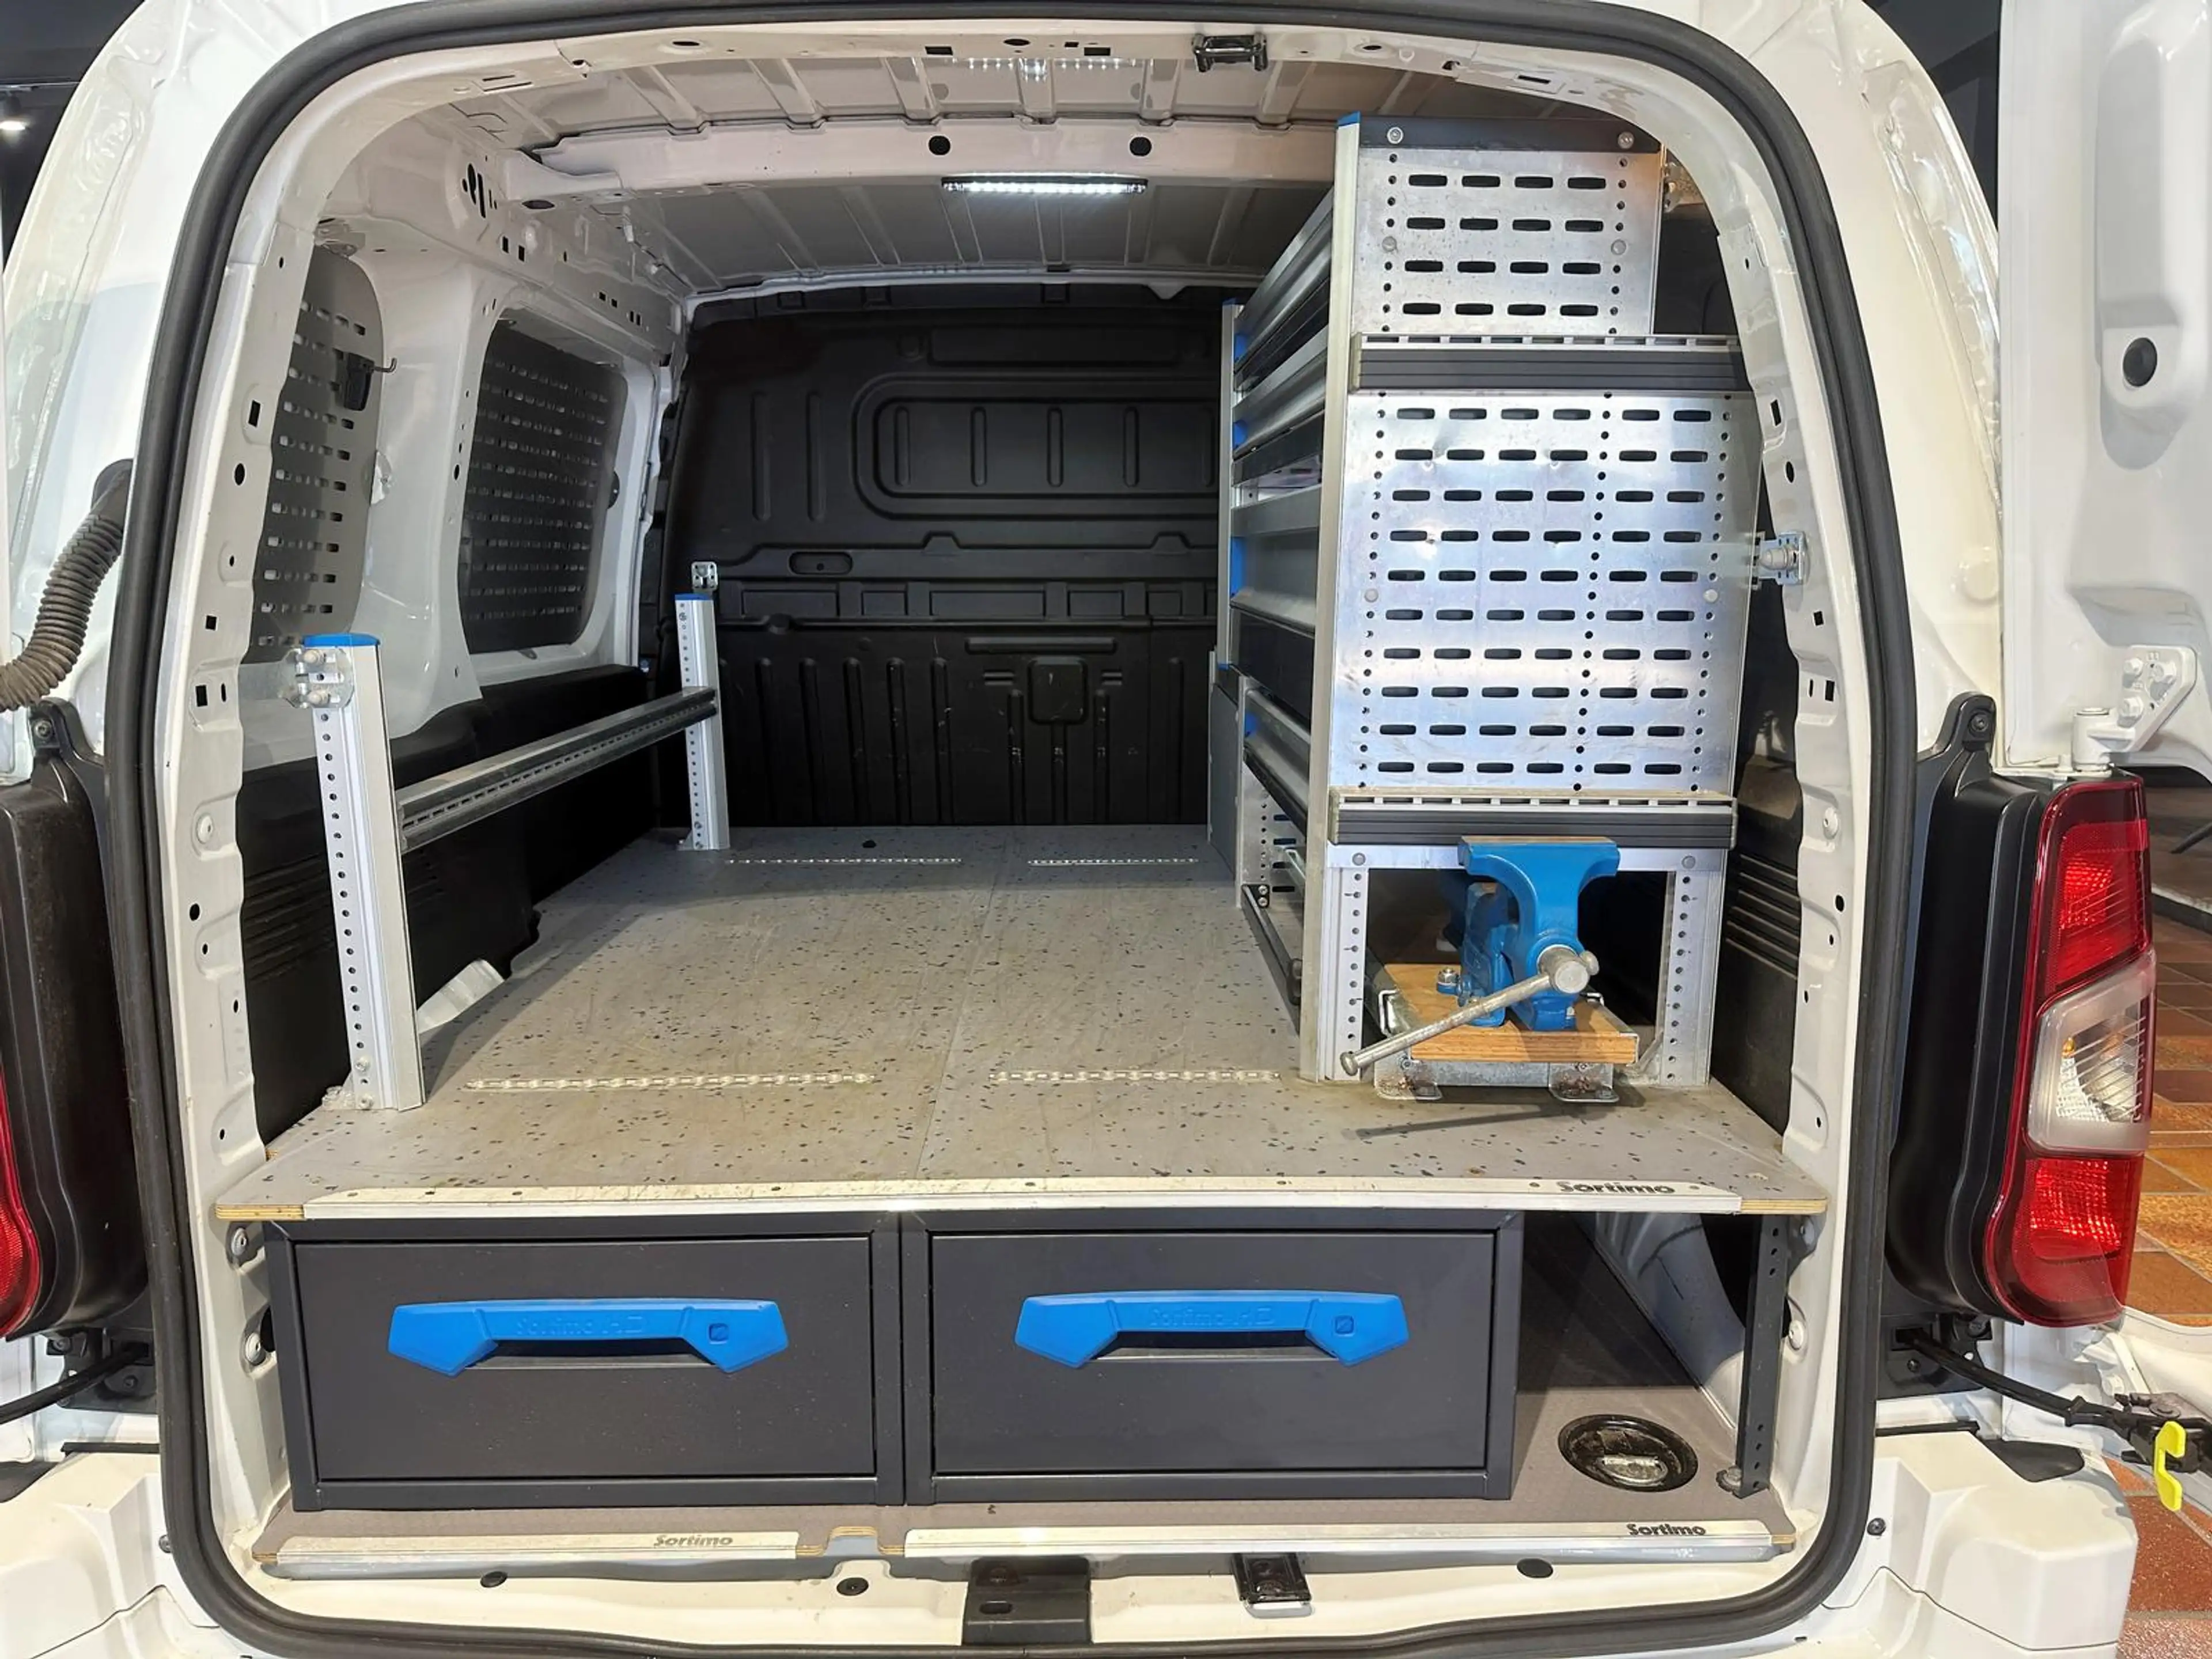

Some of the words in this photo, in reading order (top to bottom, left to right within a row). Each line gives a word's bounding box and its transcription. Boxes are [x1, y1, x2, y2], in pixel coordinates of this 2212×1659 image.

[1557, 1181, 1675, 1194] Sortimo
[1627, 1523, 1706, 1536] Sortimo
[653, 1534, 733, 1547] Sortimo
